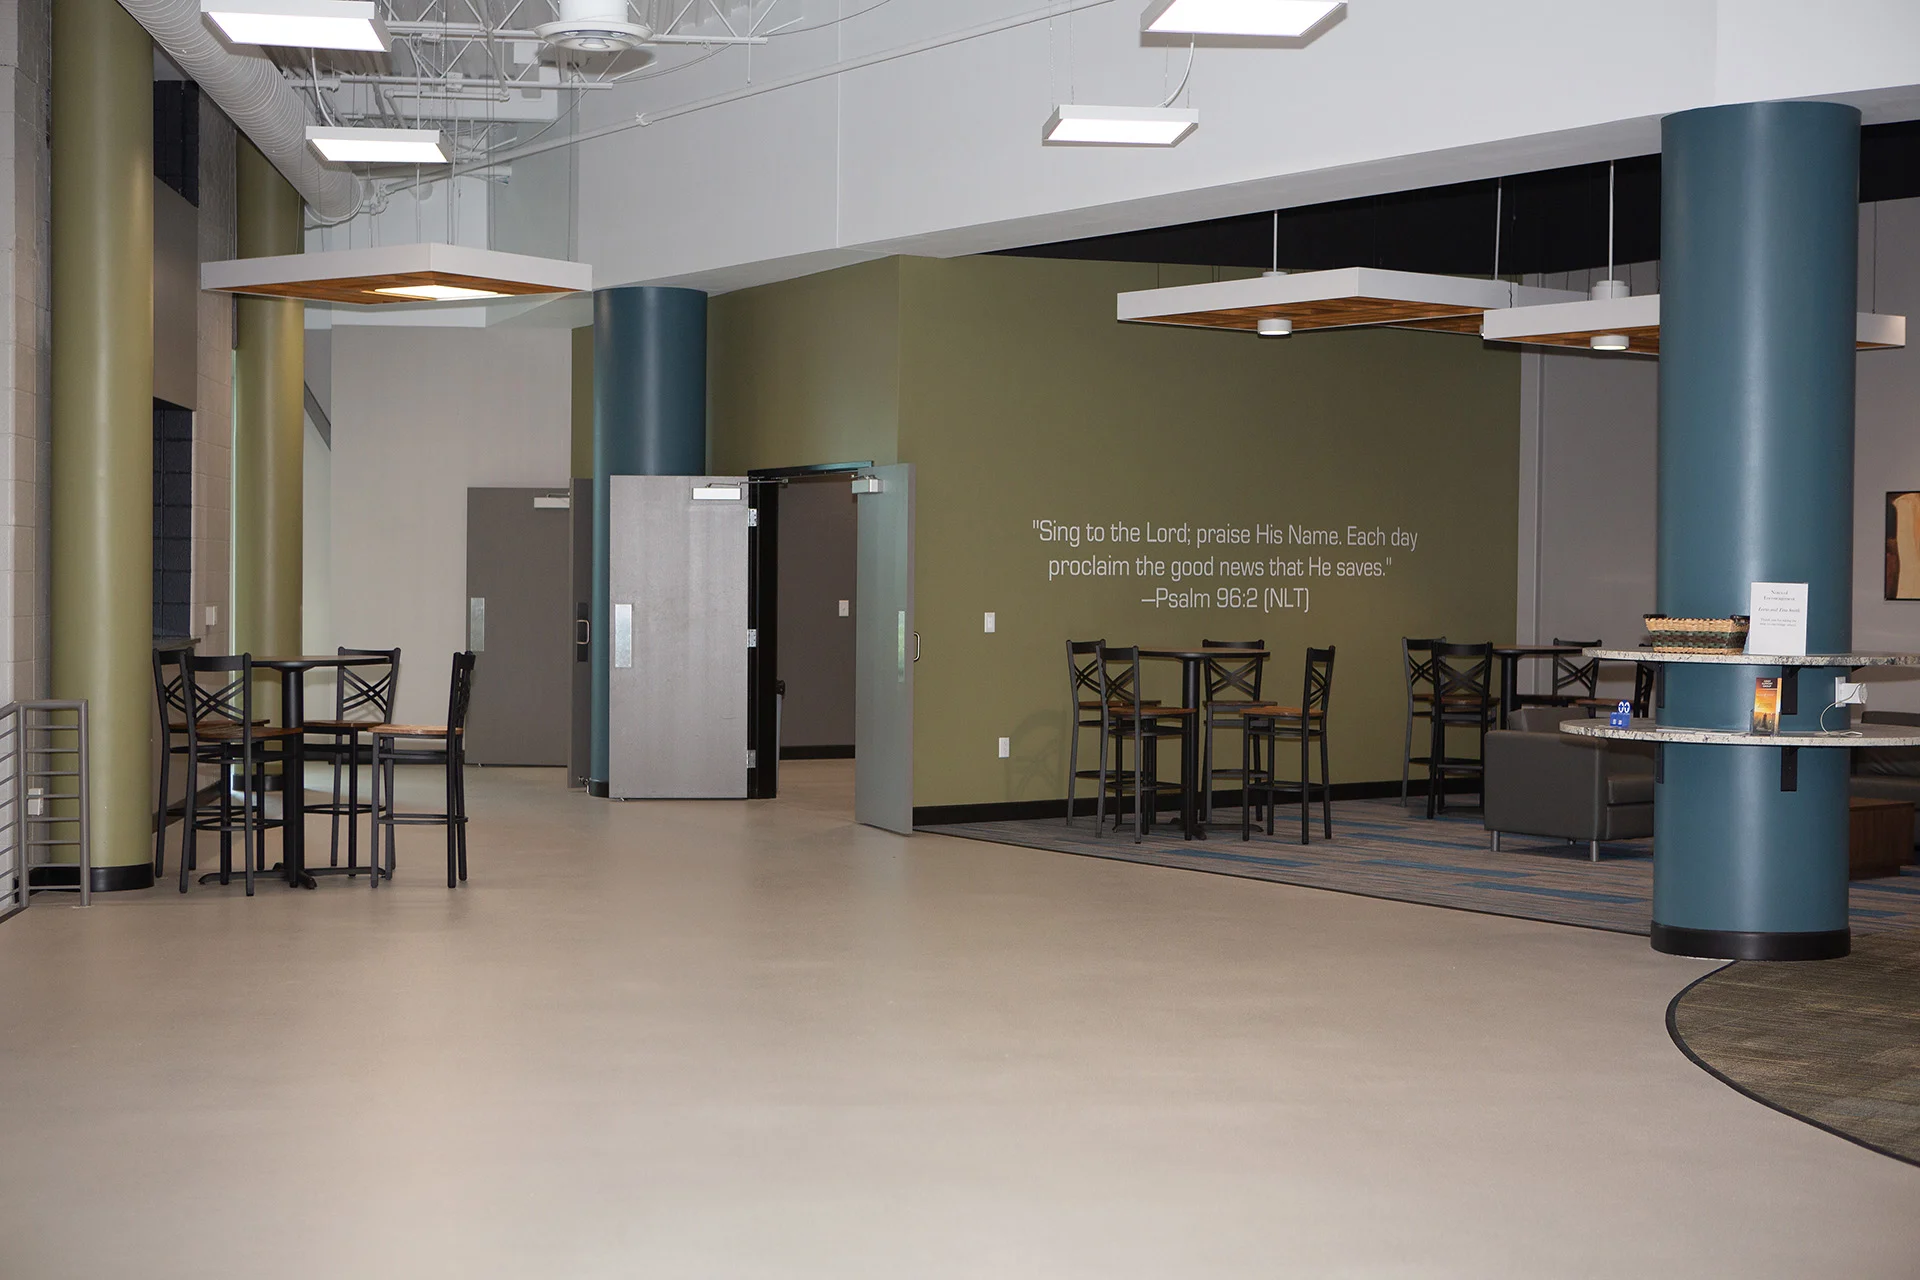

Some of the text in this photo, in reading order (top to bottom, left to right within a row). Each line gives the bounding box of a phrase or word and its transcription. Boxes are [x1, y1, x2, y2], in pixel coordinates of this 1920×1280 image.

[1032, 519, 1418, 551] "Sing to the Lord; praise His Name. Each day
[1048, 554, 1393, 582] proclaim the good news that He saves."
[1216, 587, 1258, 609] 96:2
[1264, 587, 1309, 614] (NLT)
